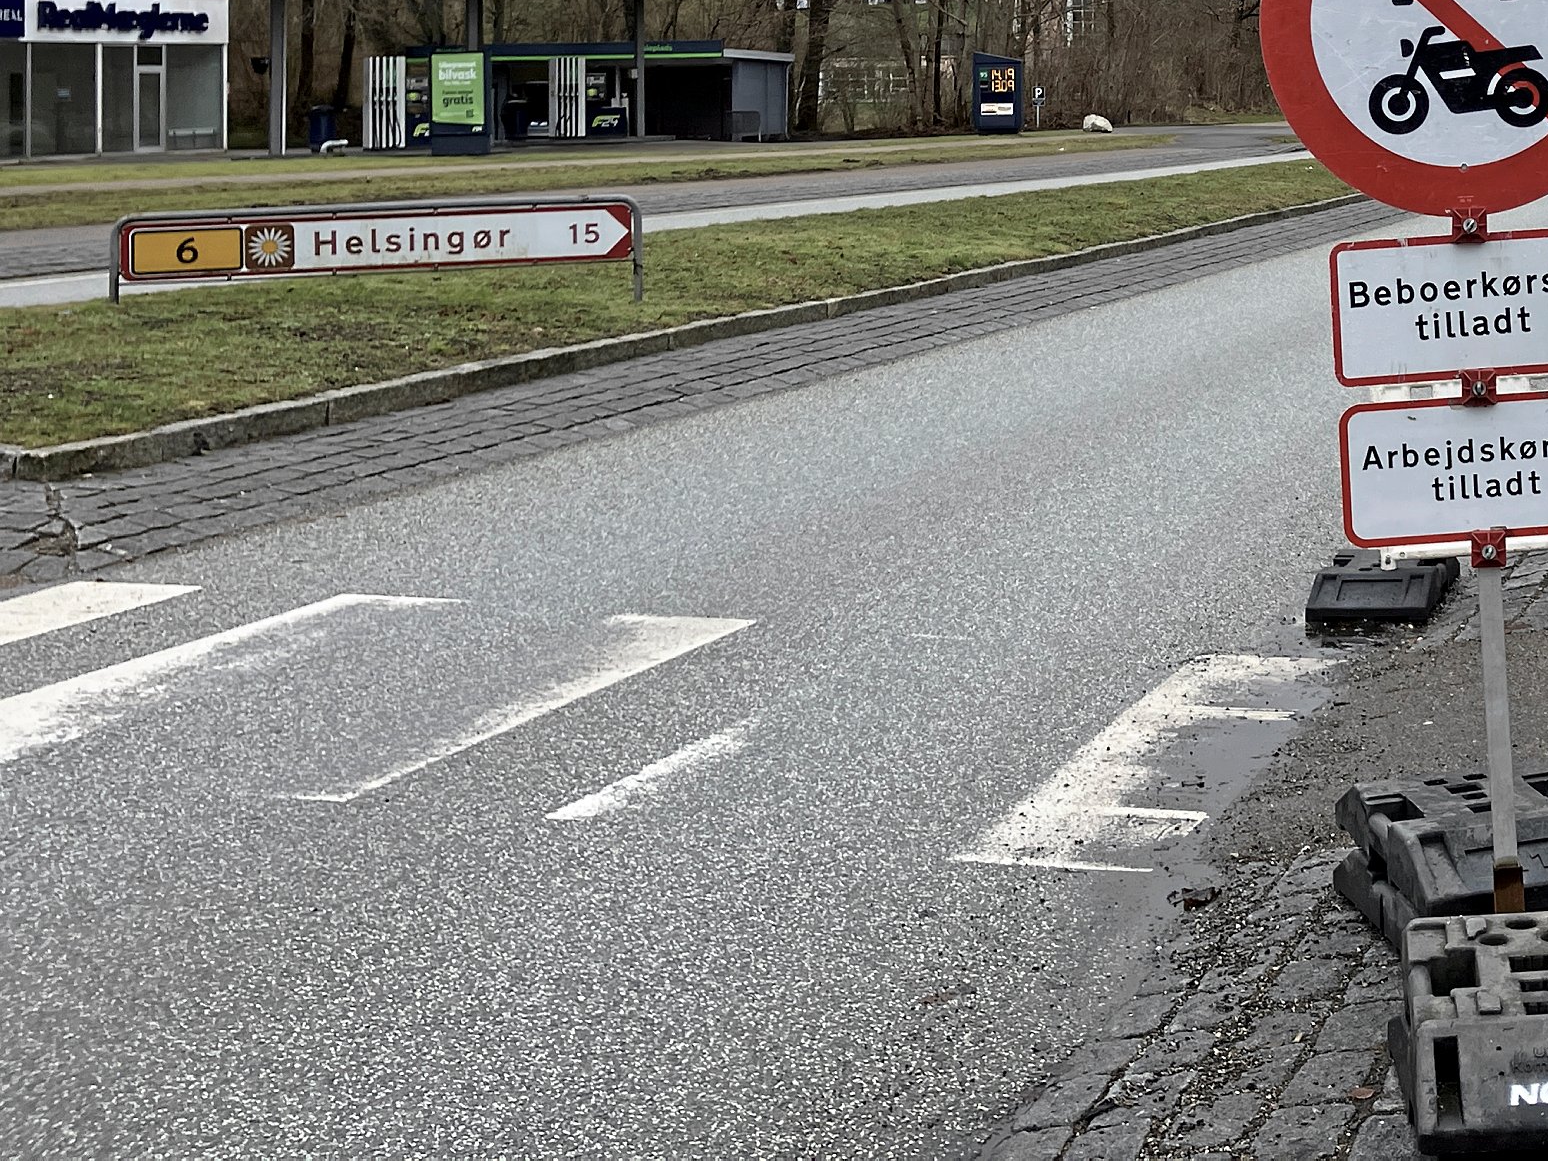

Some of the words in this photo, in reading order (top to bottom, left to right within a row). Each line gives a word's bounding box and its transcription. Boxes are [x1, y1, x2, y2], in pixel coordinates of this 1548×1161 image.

[442, 95, 474, 108] gratis
[1034, 87, 1043, 99] P
[591, 114, 620, 128] F24
[176, 237, 199, 264] 6
[314, 226, 511, 257] Helsingør
[568, 222, 600, 245] 15
[1414, 305, 1532, 341] tilladt
[1431, 469, 1542, 502] tilladt
